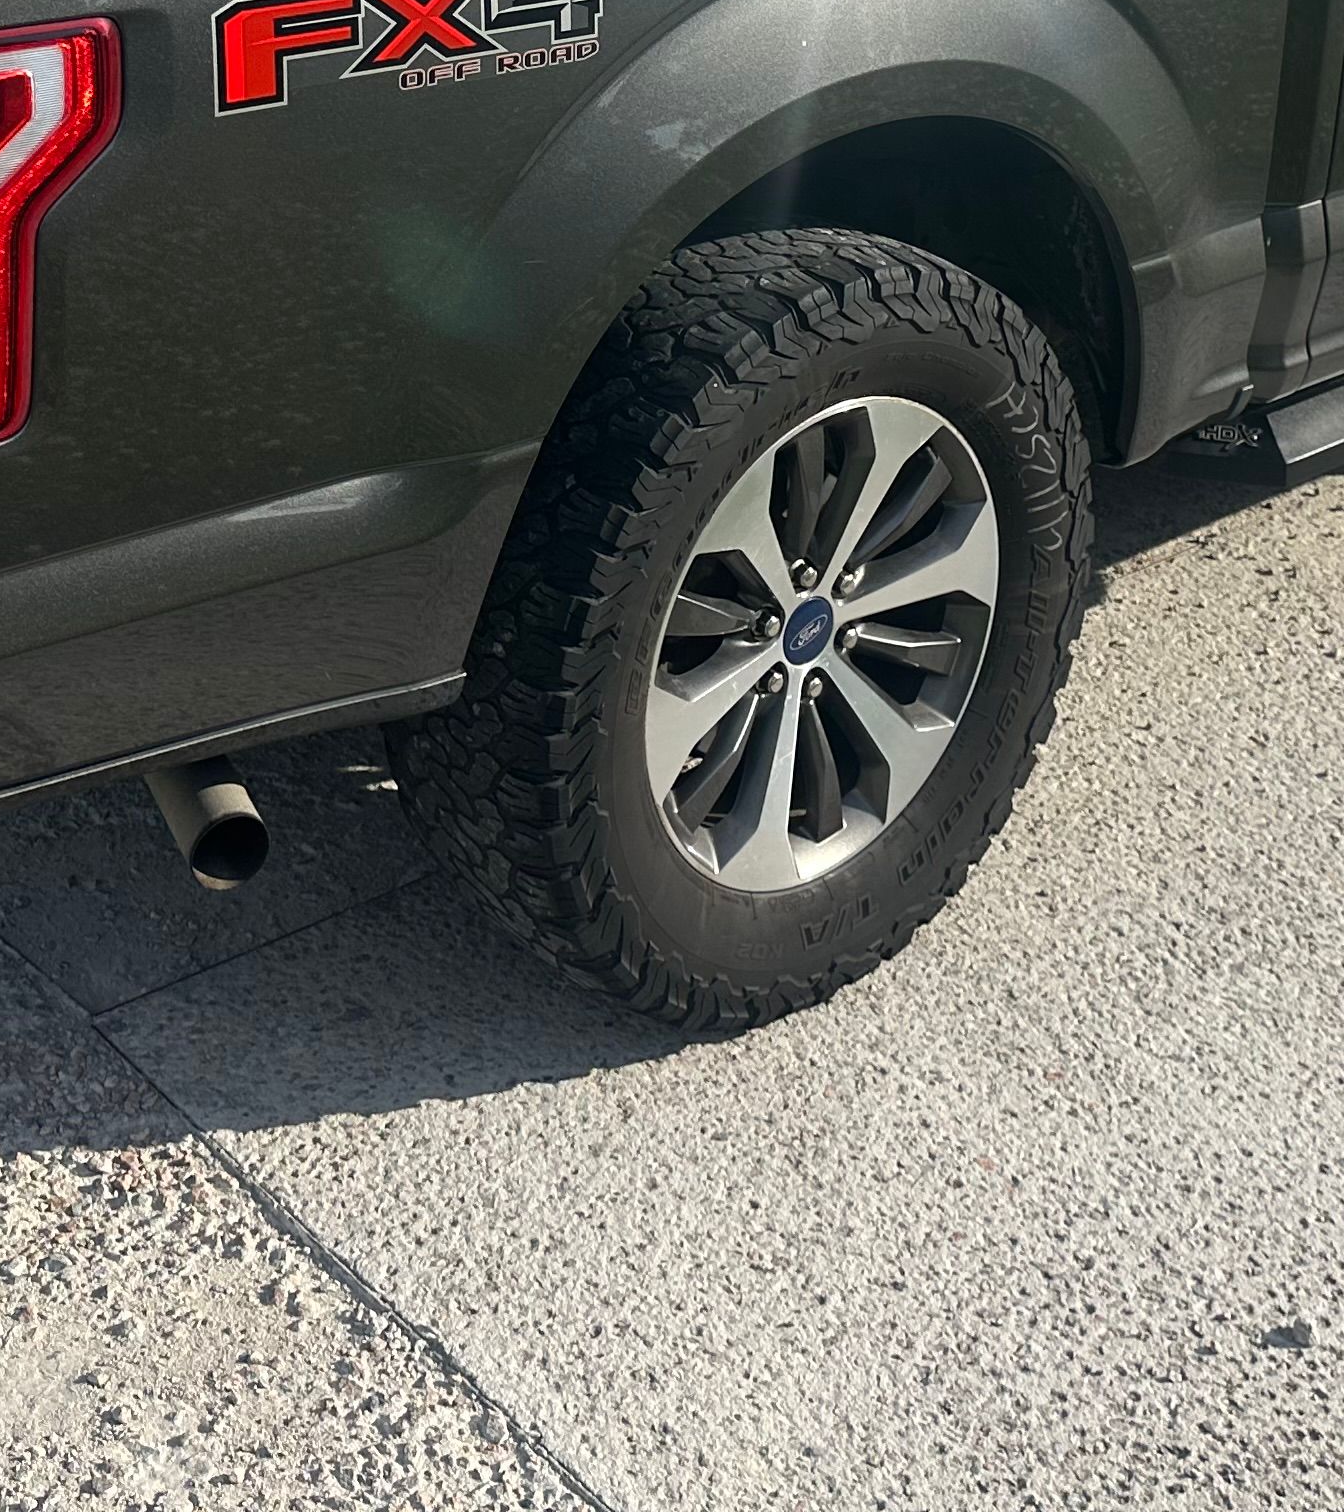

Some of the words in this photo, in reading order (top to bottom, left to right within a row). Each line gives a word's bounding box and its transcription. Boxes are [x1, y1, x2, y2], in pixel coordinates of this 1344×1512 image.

[398, 59, 482, 91] OFF
[495, 38, 602, 75] ROAD
[799, 892, 880, 953] T/A
